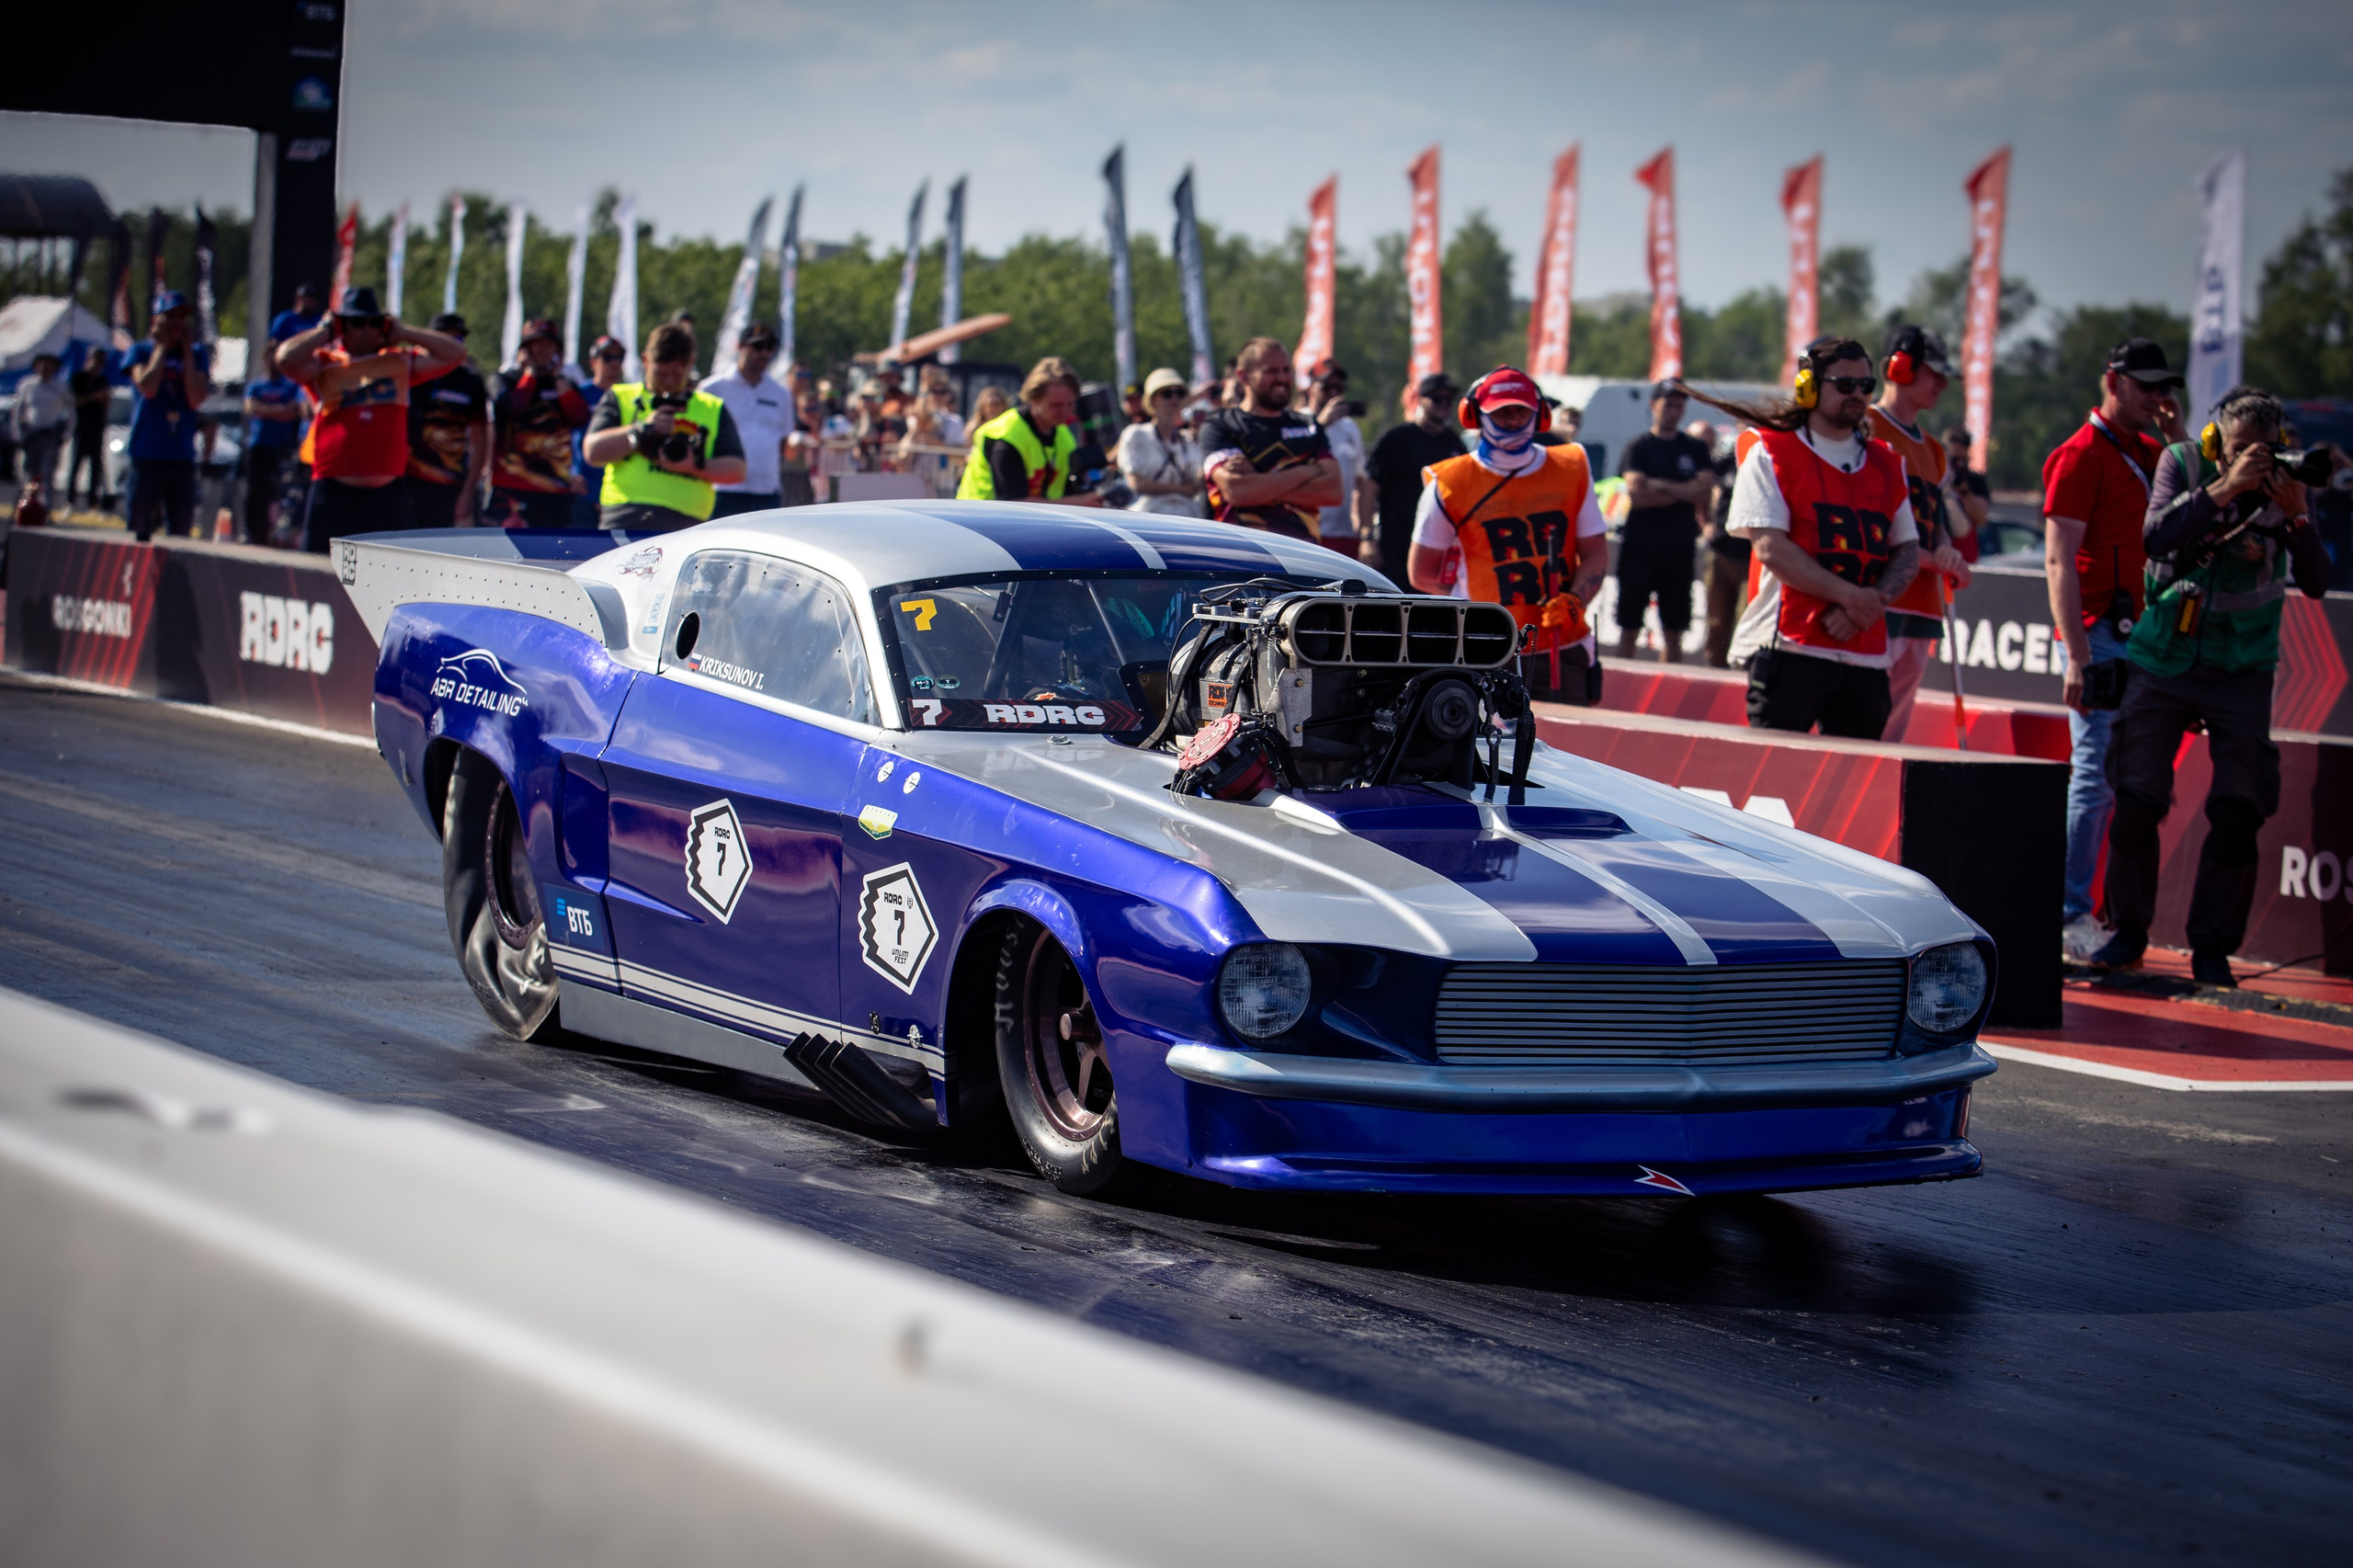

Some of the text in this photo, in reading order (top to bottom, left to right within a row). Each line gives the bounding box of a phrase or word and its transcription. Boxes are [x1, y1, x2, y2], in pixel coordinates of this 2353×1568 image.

[1481, 509, 1569, 562] RD
[1813, 503, 1892, 557] RD
[901, 598, 938, 631] 7
[240, 590, 334, 676] RDRC
[699, 655, 765, 690] KRIKSUNOV I.
[455, 683, 522, 717] DETAILING
[912, 699, 1106, 725] 7 RDRC
[714, 826, 731, 840] RDRC
[716, 841, 727, 877] 7
[883, 892, 903, 906] RDRC
[566, 905, 593, 937] ВТБ
[893, 909, 905, 946] 7
[891, 948, 909, 959] UNLIM
[893, 957, 908, 965] FEST
